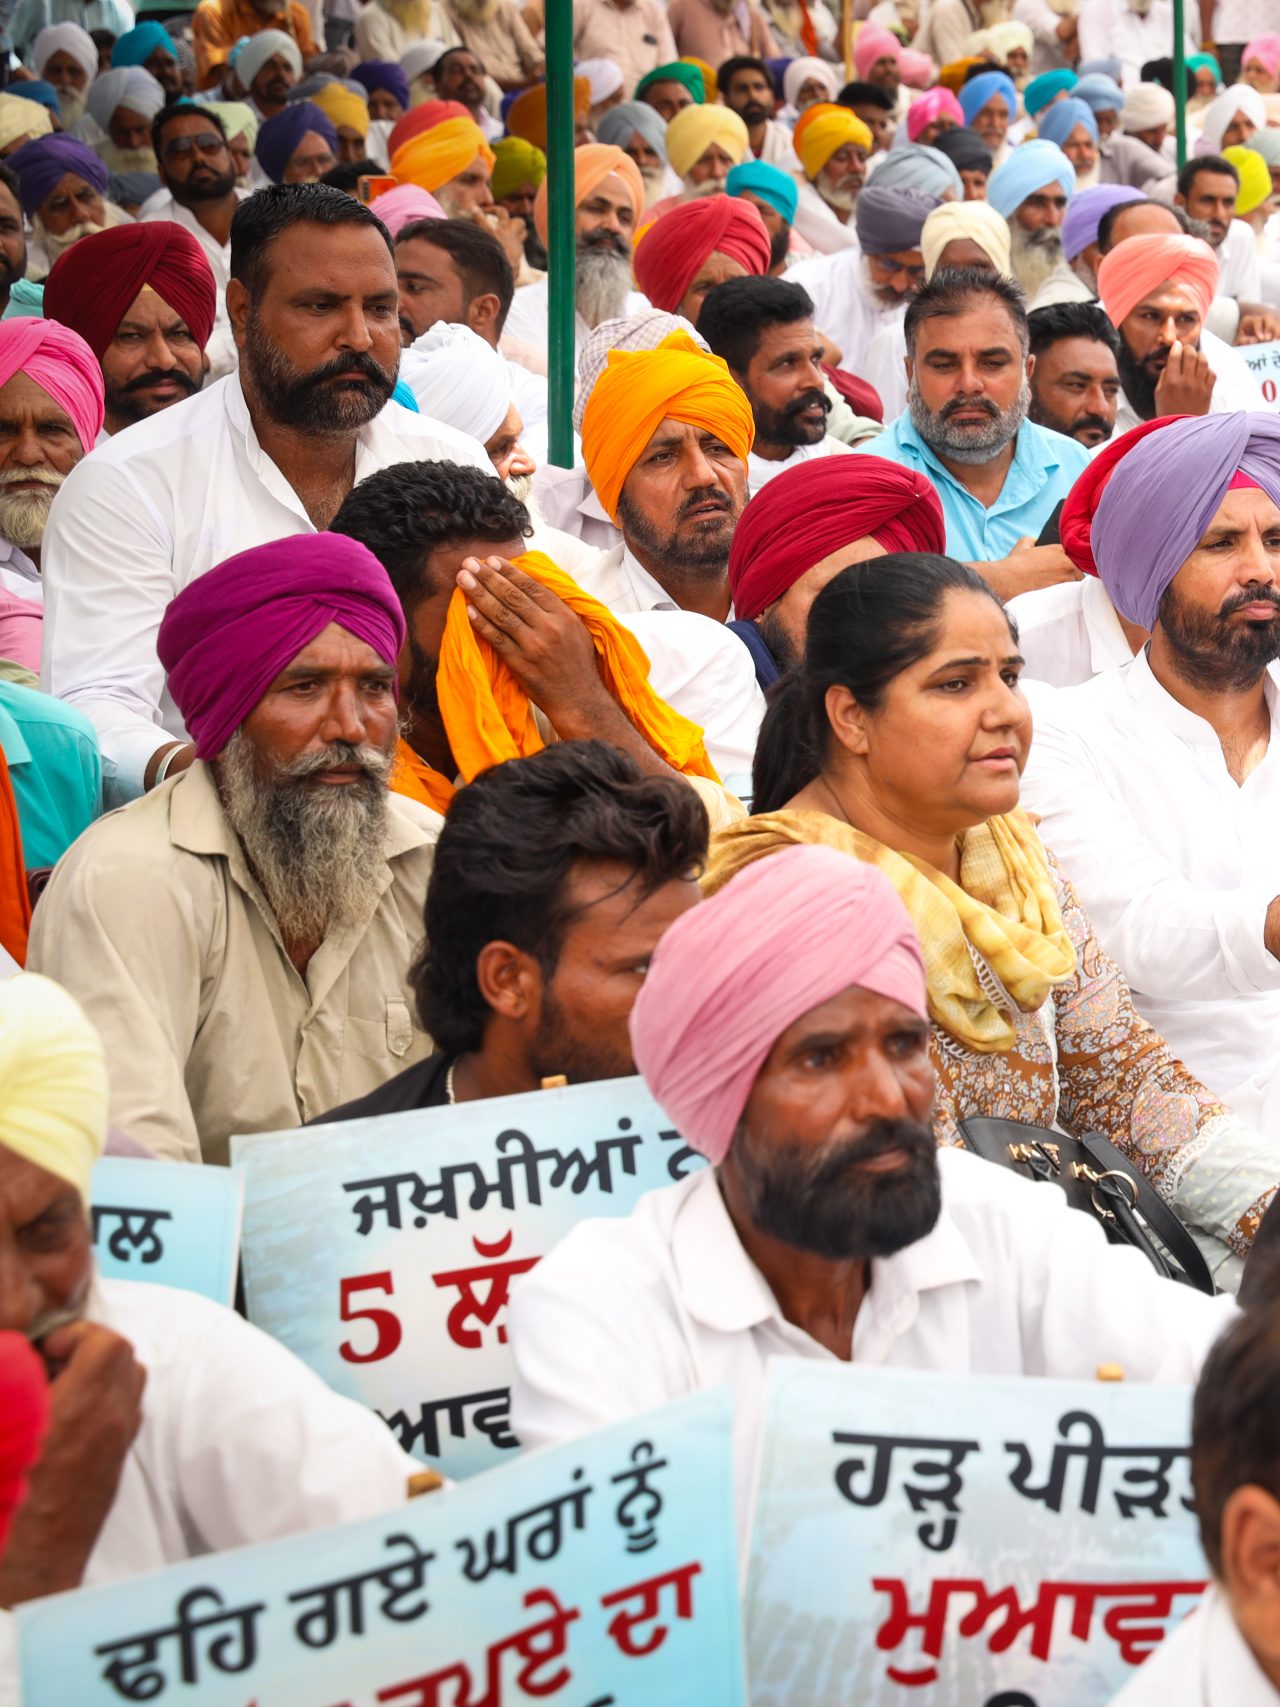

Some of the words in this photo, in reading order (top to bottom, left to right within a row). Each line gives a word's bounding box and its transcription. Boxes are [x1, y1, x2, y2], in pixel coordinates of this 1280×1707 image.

[342, 1116, 644, 1236] ਜਖ਼ਮੀਆਂ
[1003, 1410, 1198, 1519] ਪੀੜ
[96, 1585, 265, 1701] ਢਹਿ
[289, 1534, 435, 1650] ਗਏ
[455, 1467, 594, 1583] ਘਰਾਂ
[612, 1440, 669, 1554] ਨੂੰ
[600, 1561, 702, 1658] ਦਾ
[871, 1576, 1211, 1686] ਮੁਆਵ
